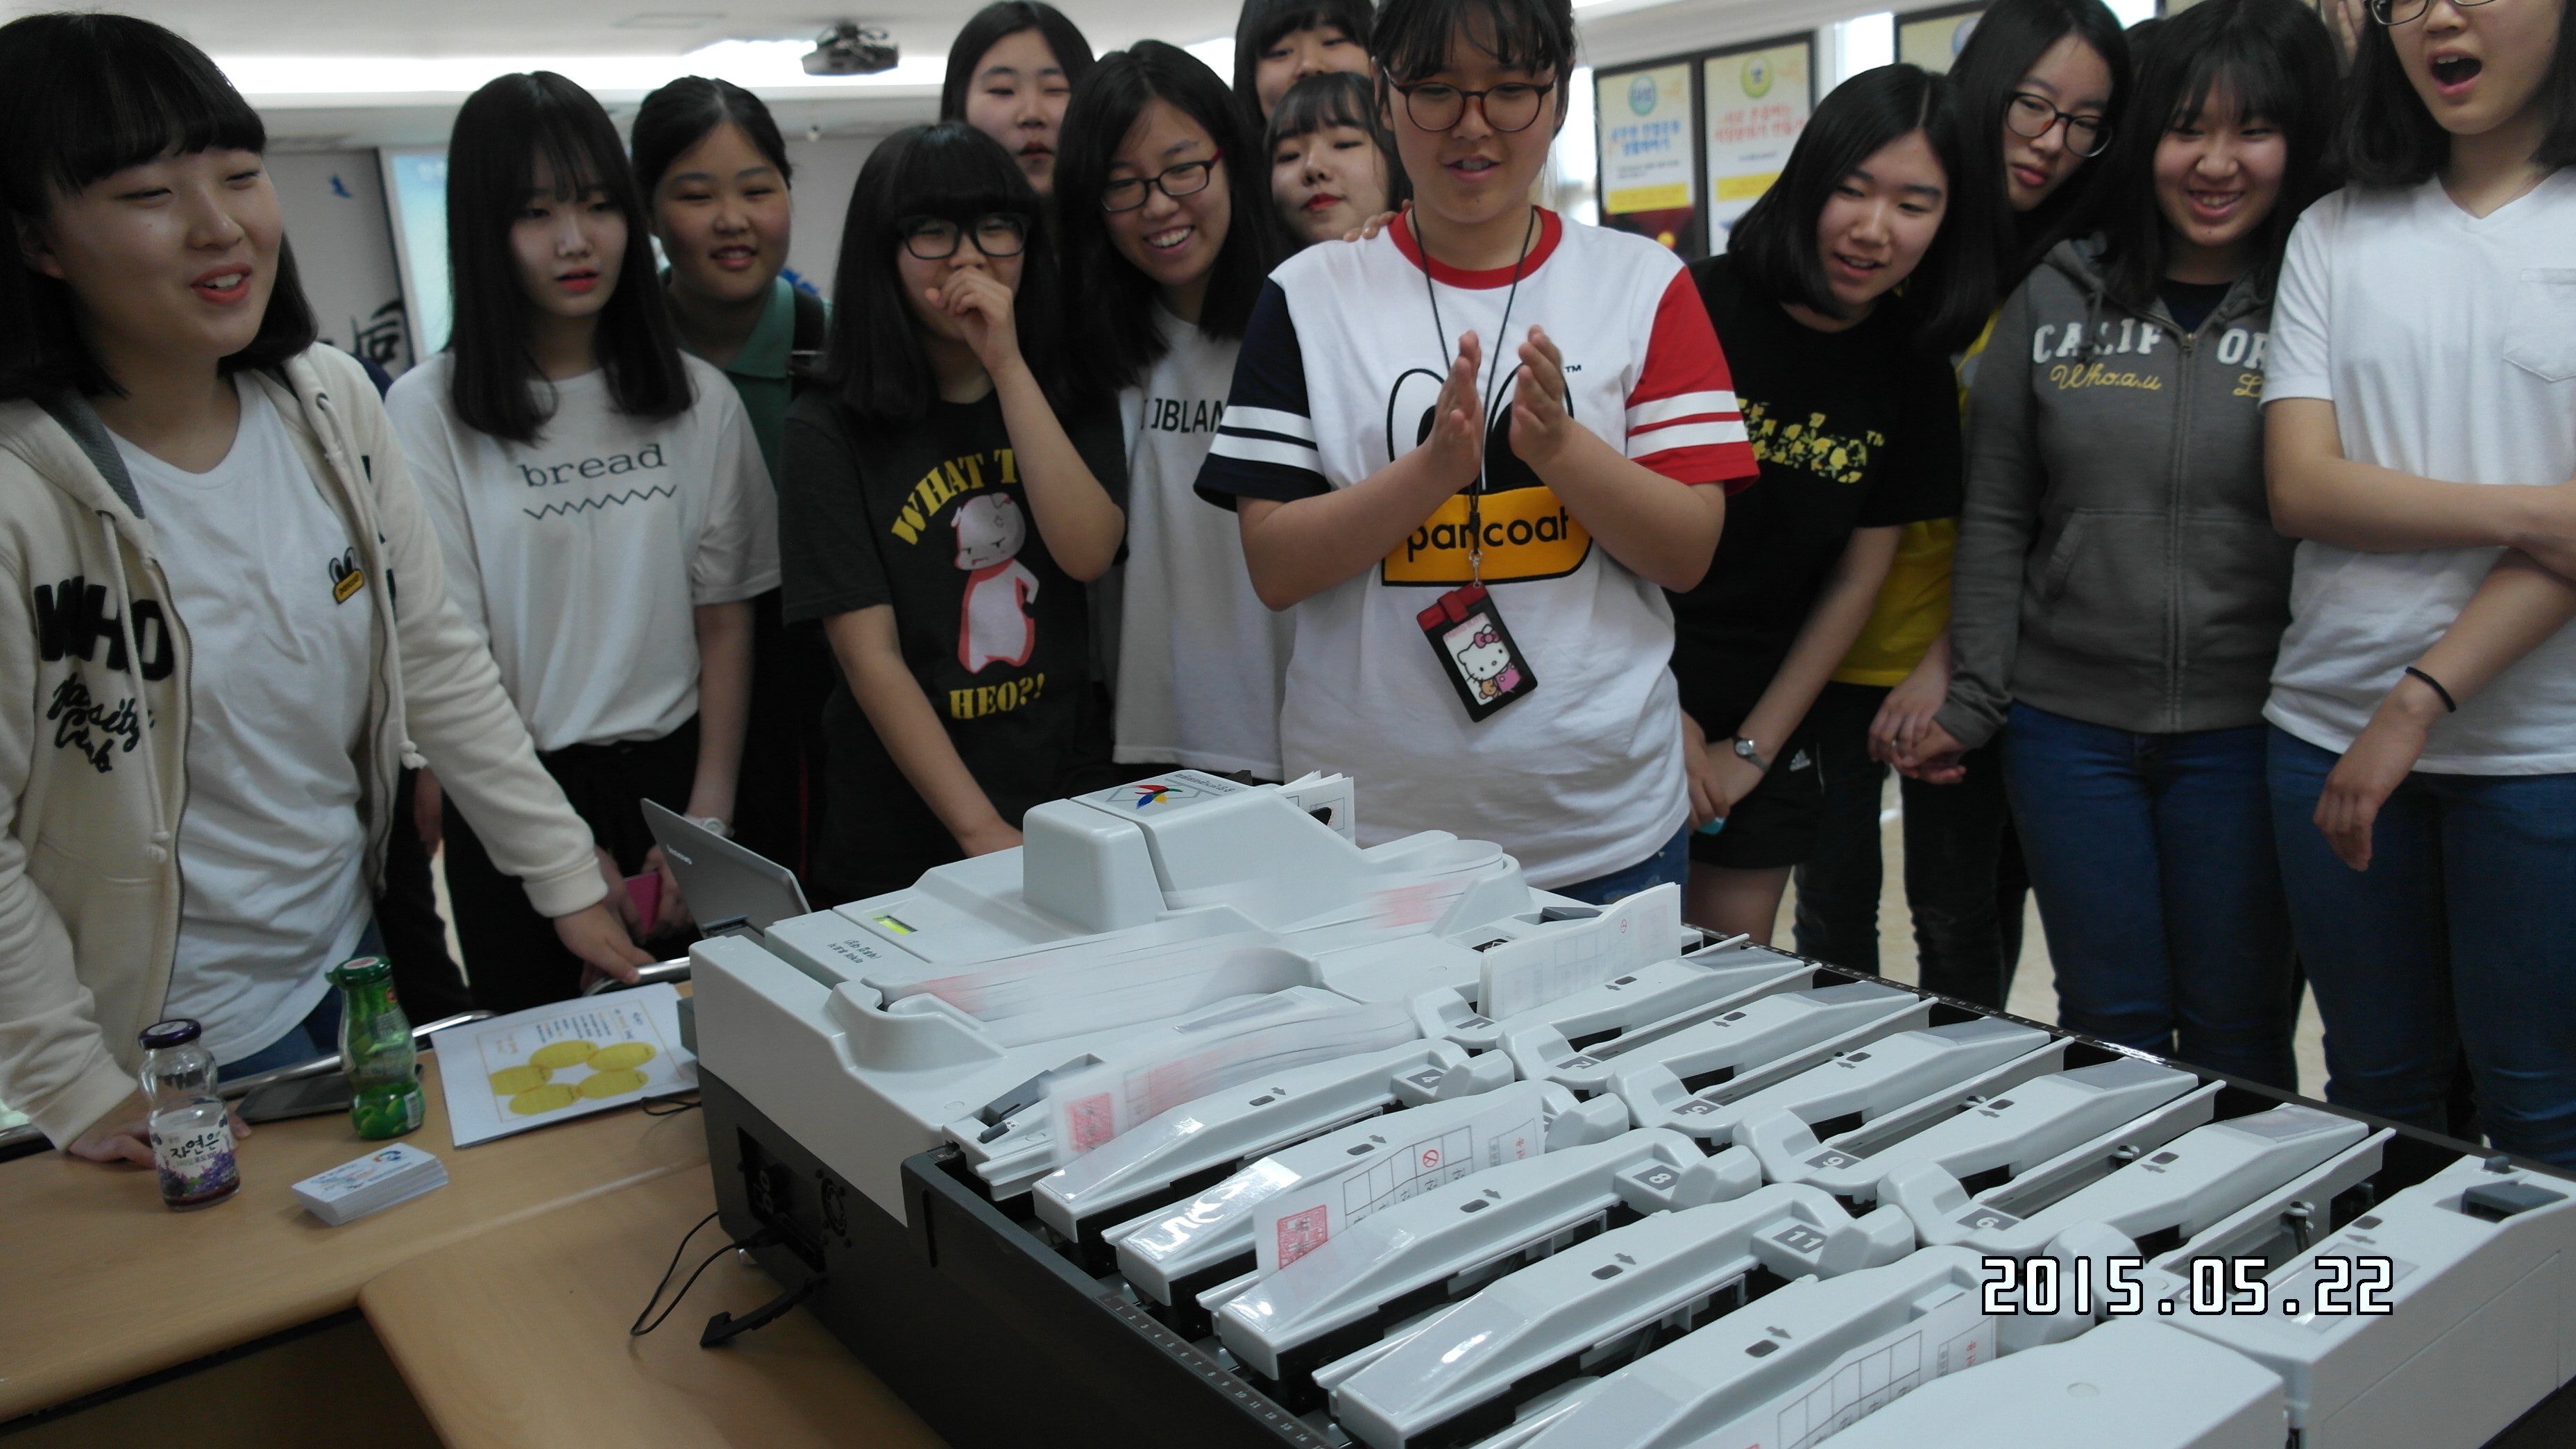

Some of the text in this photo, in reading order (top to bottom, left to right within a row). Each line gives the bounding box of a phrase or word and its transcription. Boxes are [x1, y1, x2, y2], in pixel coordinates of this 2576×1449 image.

[517, 443, 668, 487] bread
[891, 453, 985, 545] WHAT
[35, 576, 175, 681] WHO
[950, 673, 1046, 720] HEO?!
[170, 1133, 220, 1159] 자연은
[1649, 1172, 1672, 1184] 8
[1787, 1230, 1822, 1250] 11
